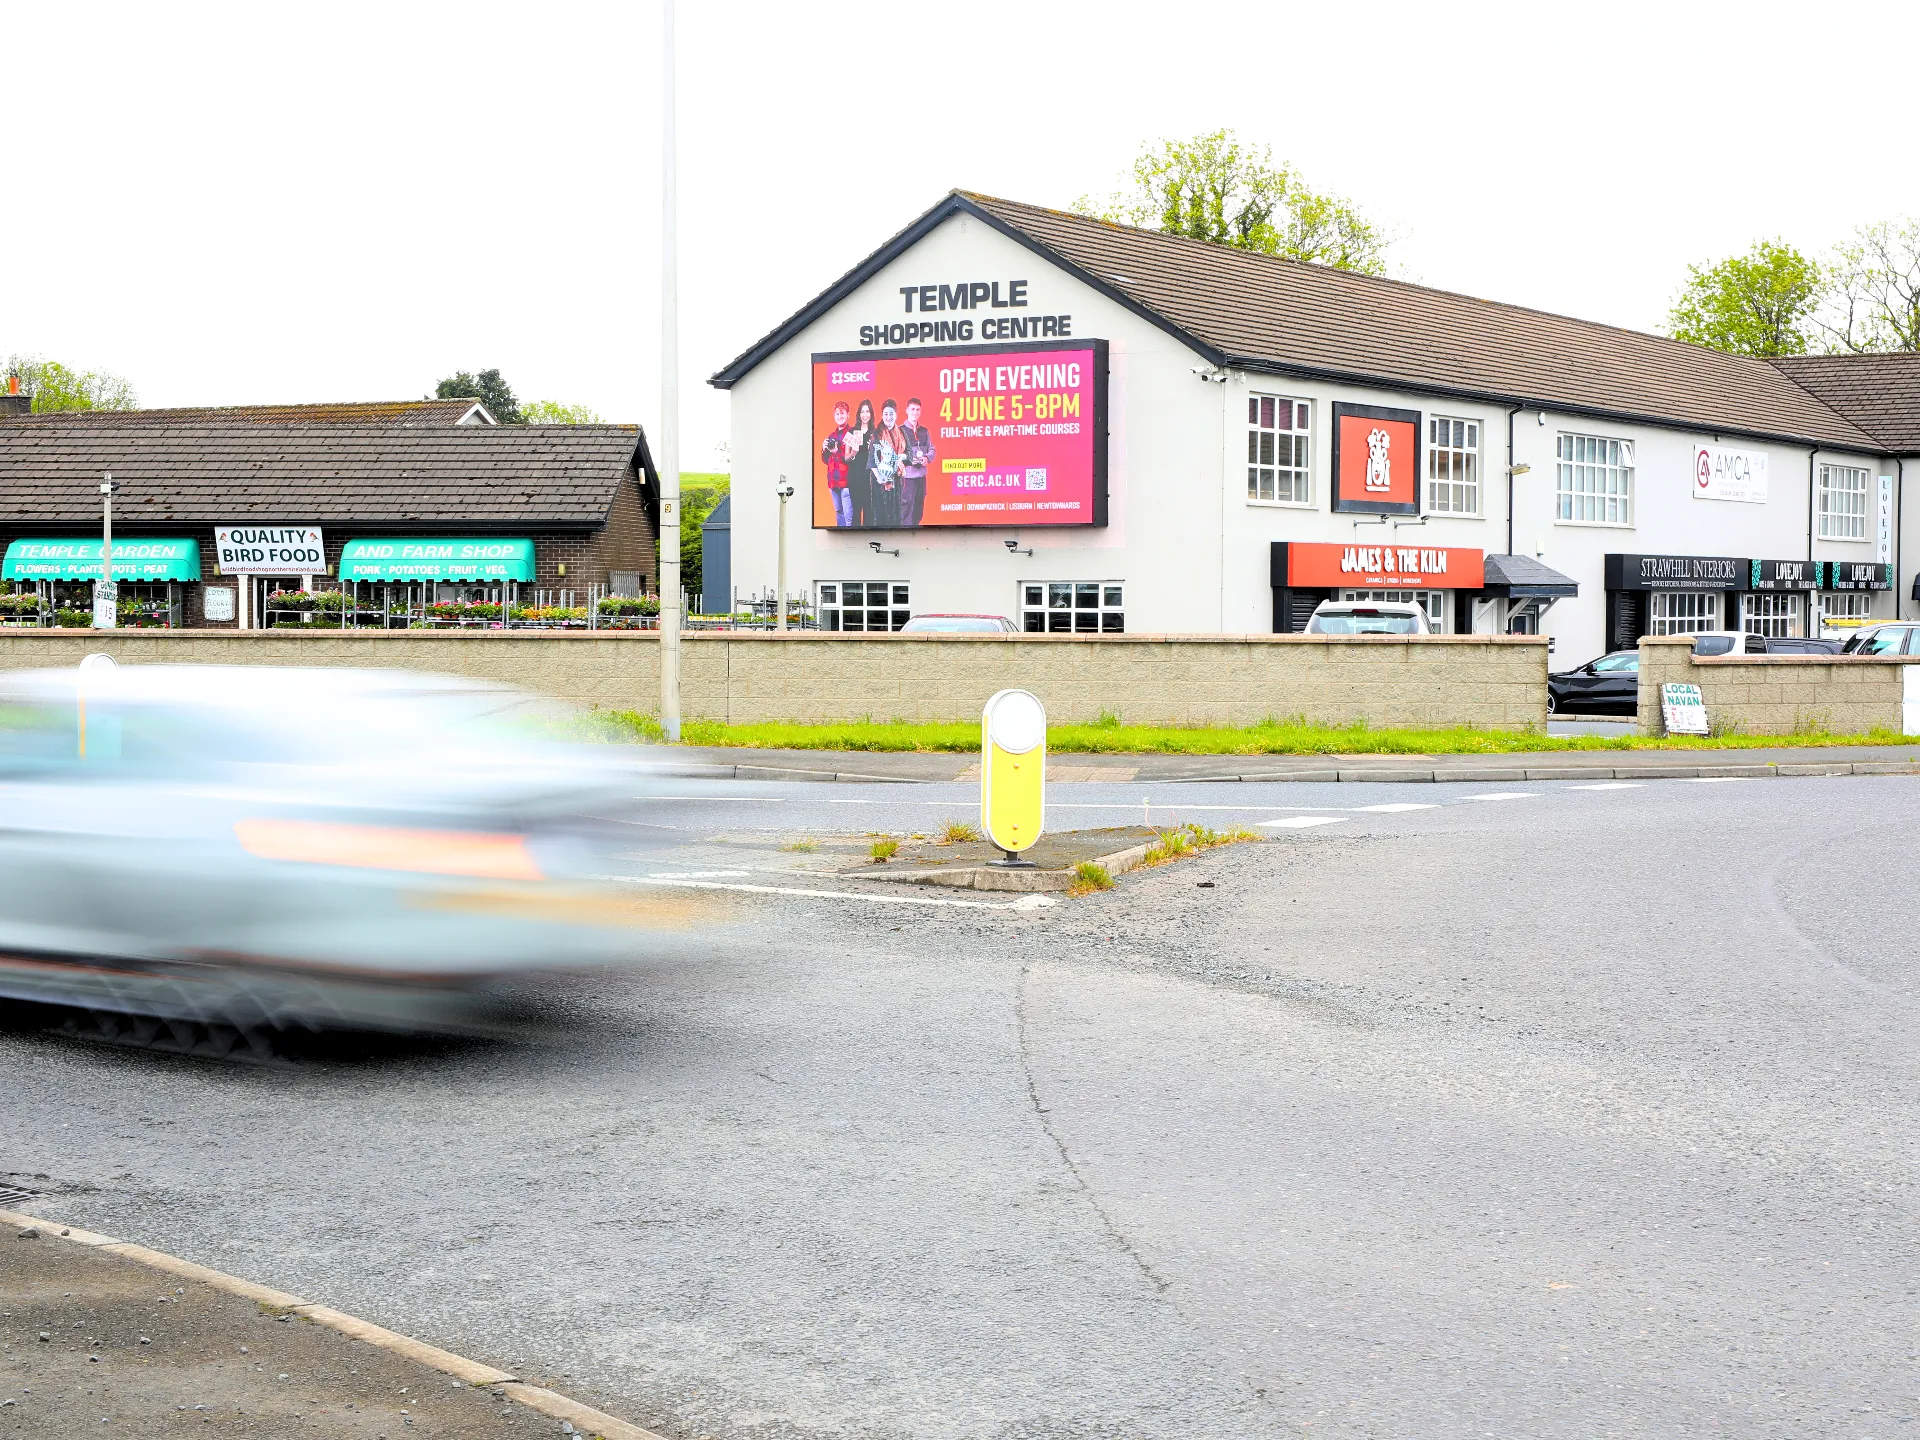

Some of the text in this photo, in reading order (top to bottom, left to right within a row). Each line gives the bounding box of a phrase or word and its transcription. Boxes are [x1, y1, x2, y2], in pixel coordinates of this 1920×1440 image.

[900, 280, 1028, 313] TEMPLE
[860, 315, 1072, 346] SHOPPING CENTRE
[843, 371, 870, 383] SERC
[939, 363, 1080, 393] OPEN EVENING
[940, 397, 953, 422] 4
[956, 395, 1005, 422] JUNE
[940, 422, 1080, 438] FULL-TIME & PART-TIME COURSES
[1714, 453, 1751, 482] AMCA
[956, 474, 1021, 488] SERC.AC.UK
[940, 501, 1081, 511] BANGOR DOWNPATRICK LISBURN NEWTOWNARDS
[230, 529, 306, 545] QUALITY
[19, 545, 91, 557] TEMPLE
[222, 548, 320, 562] BIRD FOOD
[353, 545, 514, 558] AND FARM SHOP
[1341, 547, 1447, 574] JAMES & THE KILN
[1641, 558, 1736, 579] STRAWHILL INTERIORS
[15, 564, 168, 574] FLOWERS PLANTS POTS PEAT
[353, 565, 508, 575] PORK POTATOES FRUIT VEG.
[1775, 562, 1804, 580] LOVEJOY
[1851, 564, 1876, 582] LOVEJOY
[1665, 684, 1699, 695] LOCAL
[1667, 695, 1700, 706] NAVAN
